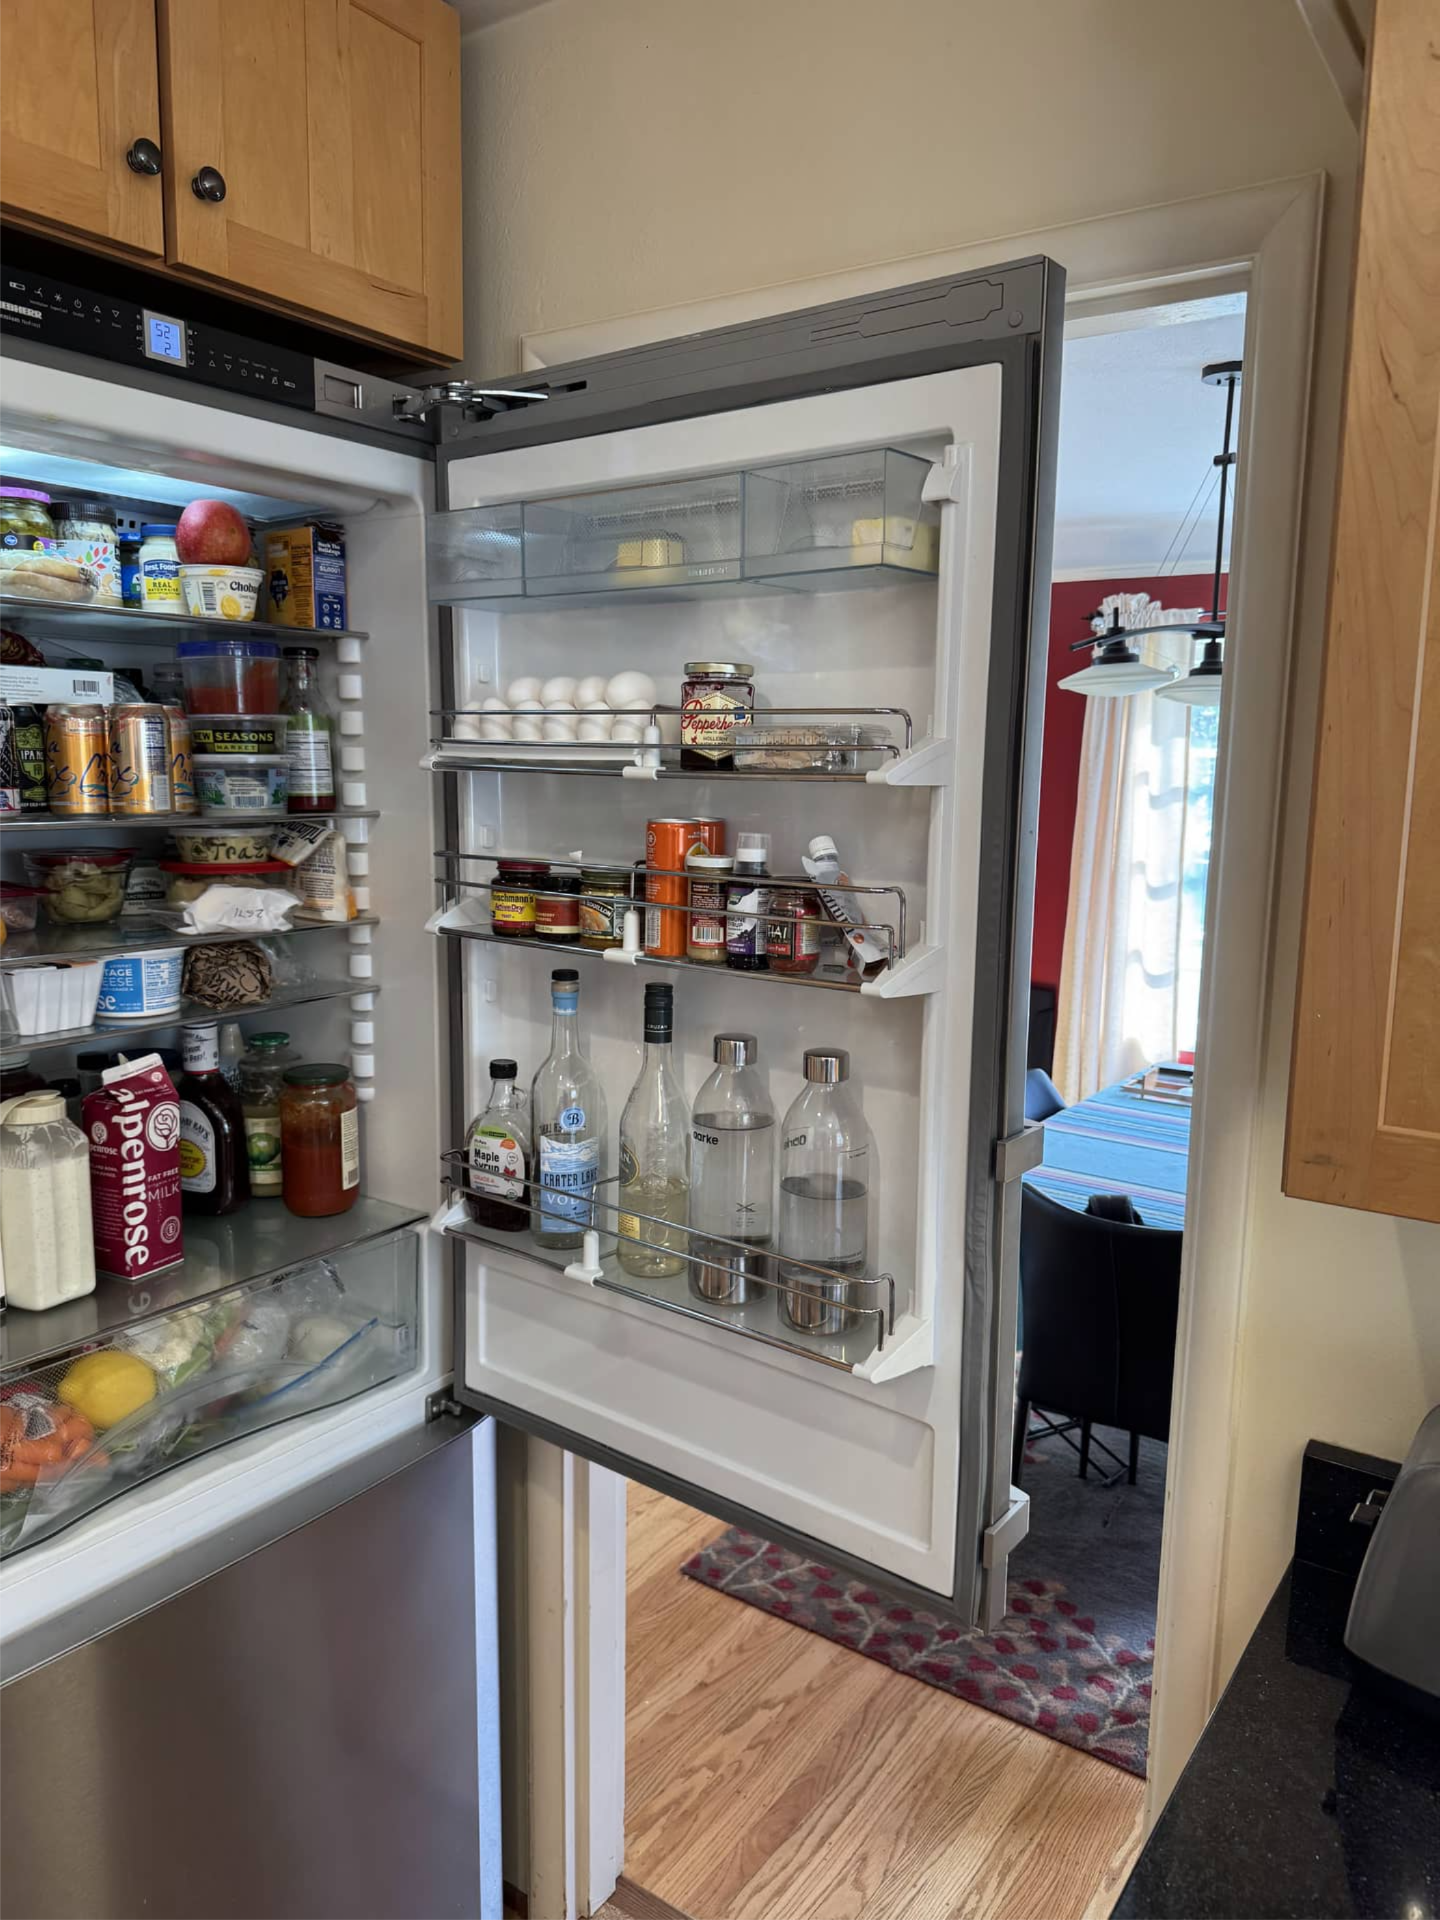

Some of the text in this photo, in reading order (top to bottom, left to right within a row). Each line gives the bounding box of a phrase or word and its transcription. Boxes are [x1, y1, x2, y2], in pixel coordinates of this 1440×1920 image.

[156, 322, 171, 340] 52
[164, 341, 171, 356] 2
[159, 563, 177, 572] Food
[194, 730, 274, 742] EW SEASONS
[20, 750, 35, 760] IPA
[215, 743, 257, 752] MARKET
[105, 968, 133, 977] TAGE
[103, 977, 134, 987] EESE
[567, 1112, 580, 1126] B
[693, 1130, 719, 1146] aarke
[474, 1148, 500, 1163] Maple
[109, 1088, 150, 1267] alpenrose
[147, 1172, 162, 1182] FAT
[163, 1167, 179, 1177] FREE
[544, 1167, 598, 1188] CRATER LAKE
[148, 1182, 180, 1203] MILK
